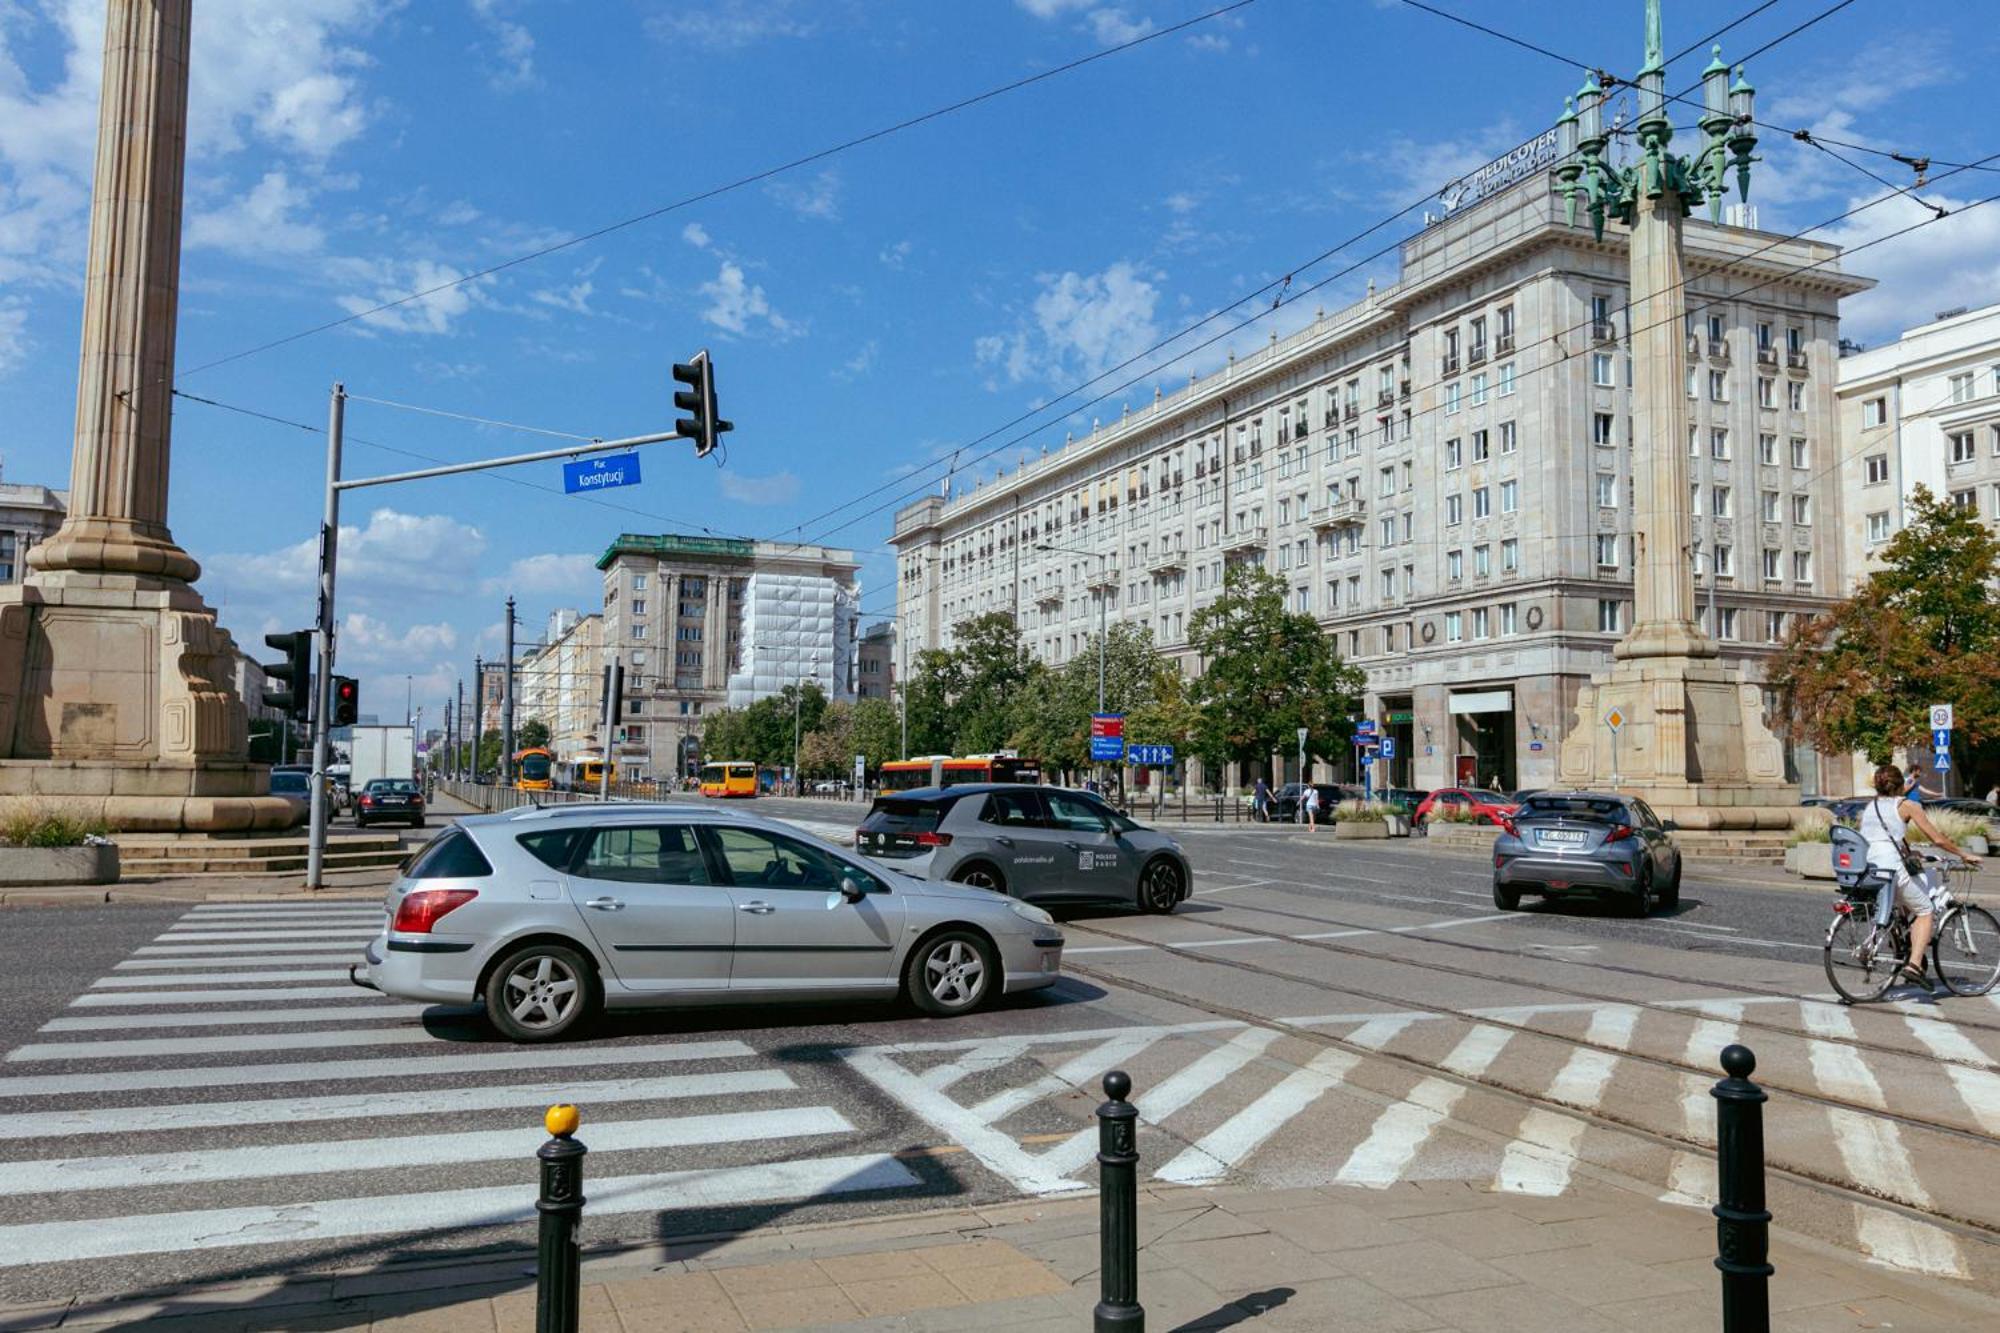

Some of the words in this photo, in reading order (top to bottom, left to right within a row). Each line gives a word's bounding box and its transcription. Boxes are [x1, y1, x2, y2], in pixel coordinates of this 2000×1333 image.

[1473, 129, 1557, 185] MEDICOVER
[579, 467, 624, 487] Konstytucji
[1383, 739, 1392, 757] P
